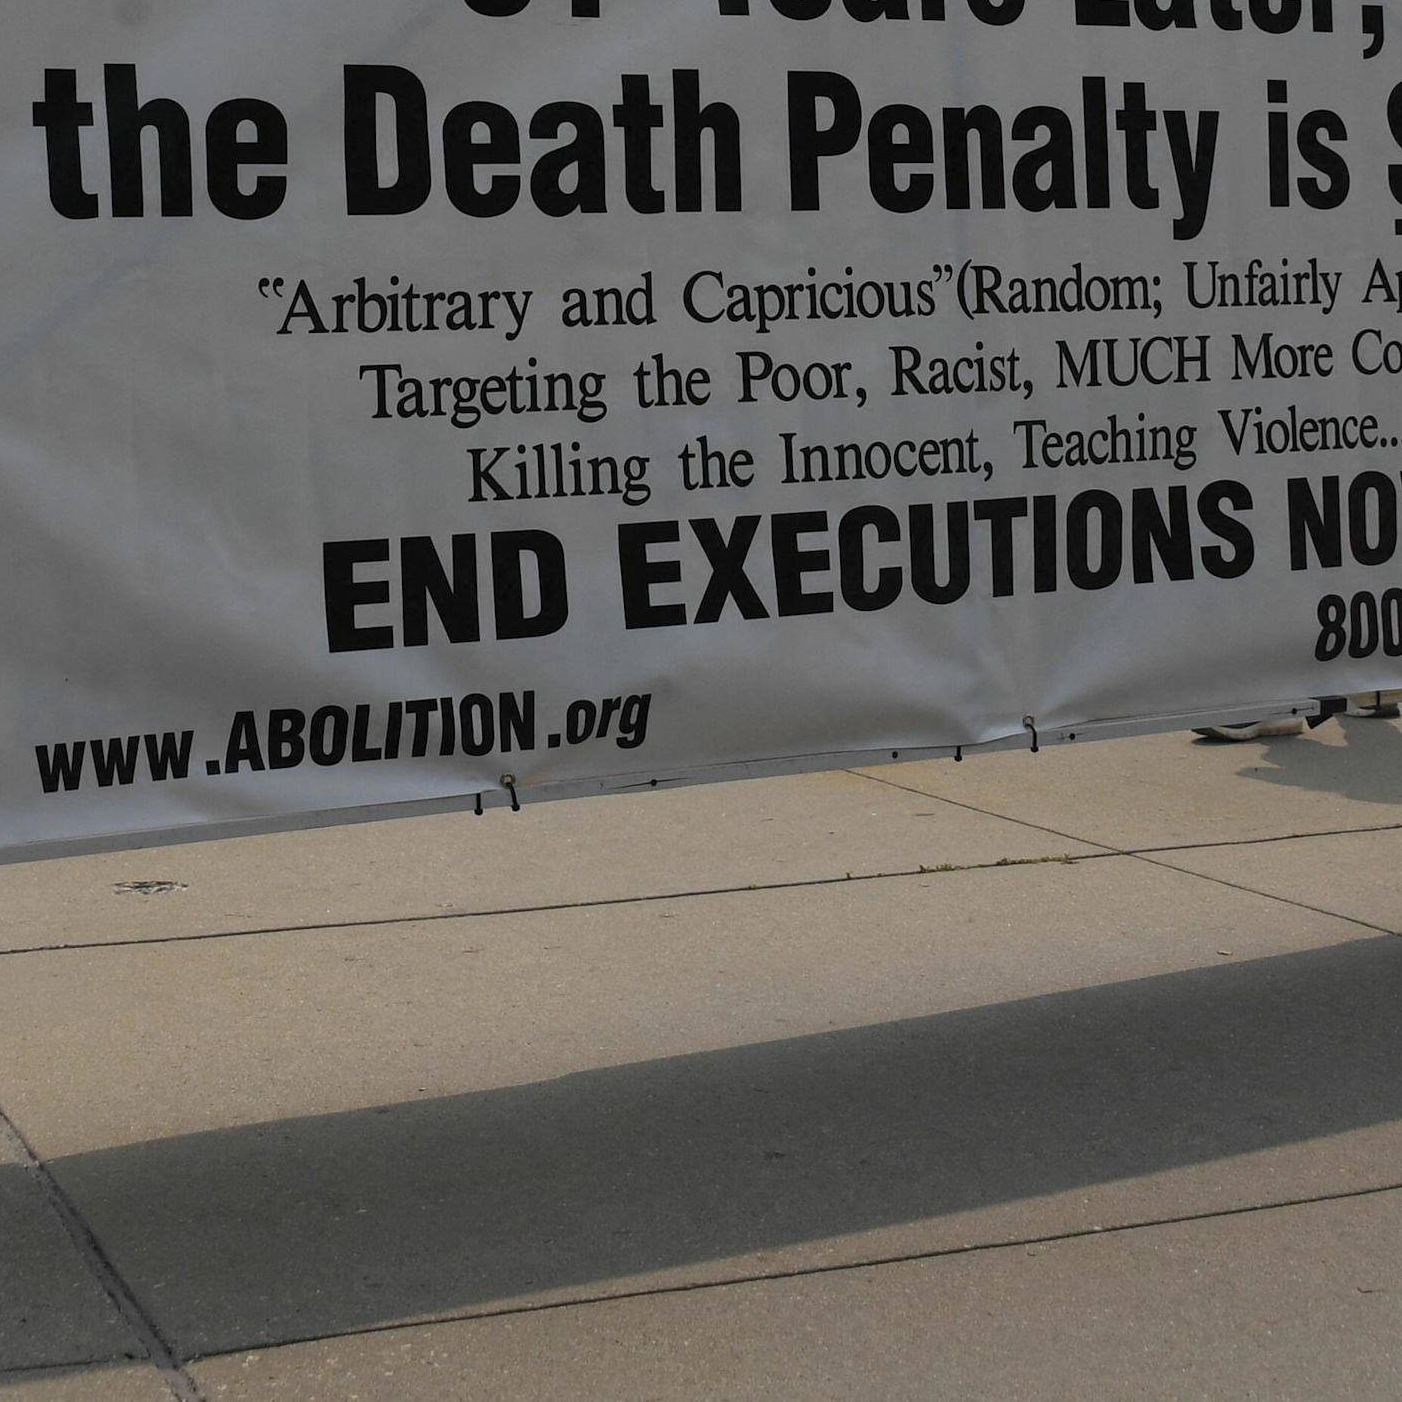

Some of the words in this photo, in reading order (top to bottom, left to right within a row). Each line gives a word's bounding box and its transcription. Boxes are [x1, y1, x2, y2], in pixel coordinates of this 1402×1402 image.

[32, 63, 288, 221] the
[343, 63, 742, 219] Death
[787, 70, 1220, 241] Penalty
[1266, 79, 1351, 211] is
[562, 271, 657, 327] and
[1183, 258, 1342, 314] Unfairly
[359, 356, 608, 429] Targeting
[632, 352, 711, 409] the
[735, 351, 867, 409] Poor,
[888, 341, 1034, 401] Racist,
[1054, 335, 1212, 389] MUCH
[1230, 332, 1334, 381] More
[466, 441, 652, 507] Killing
[677, 434, 755, 491] the
[778, 429, 994, 484] Innocent,
[1013, 412, 1198, 471] Teaching
[322, 529, 569, 654] END
[617, 479, 1255, 630] EXECUTIONS
